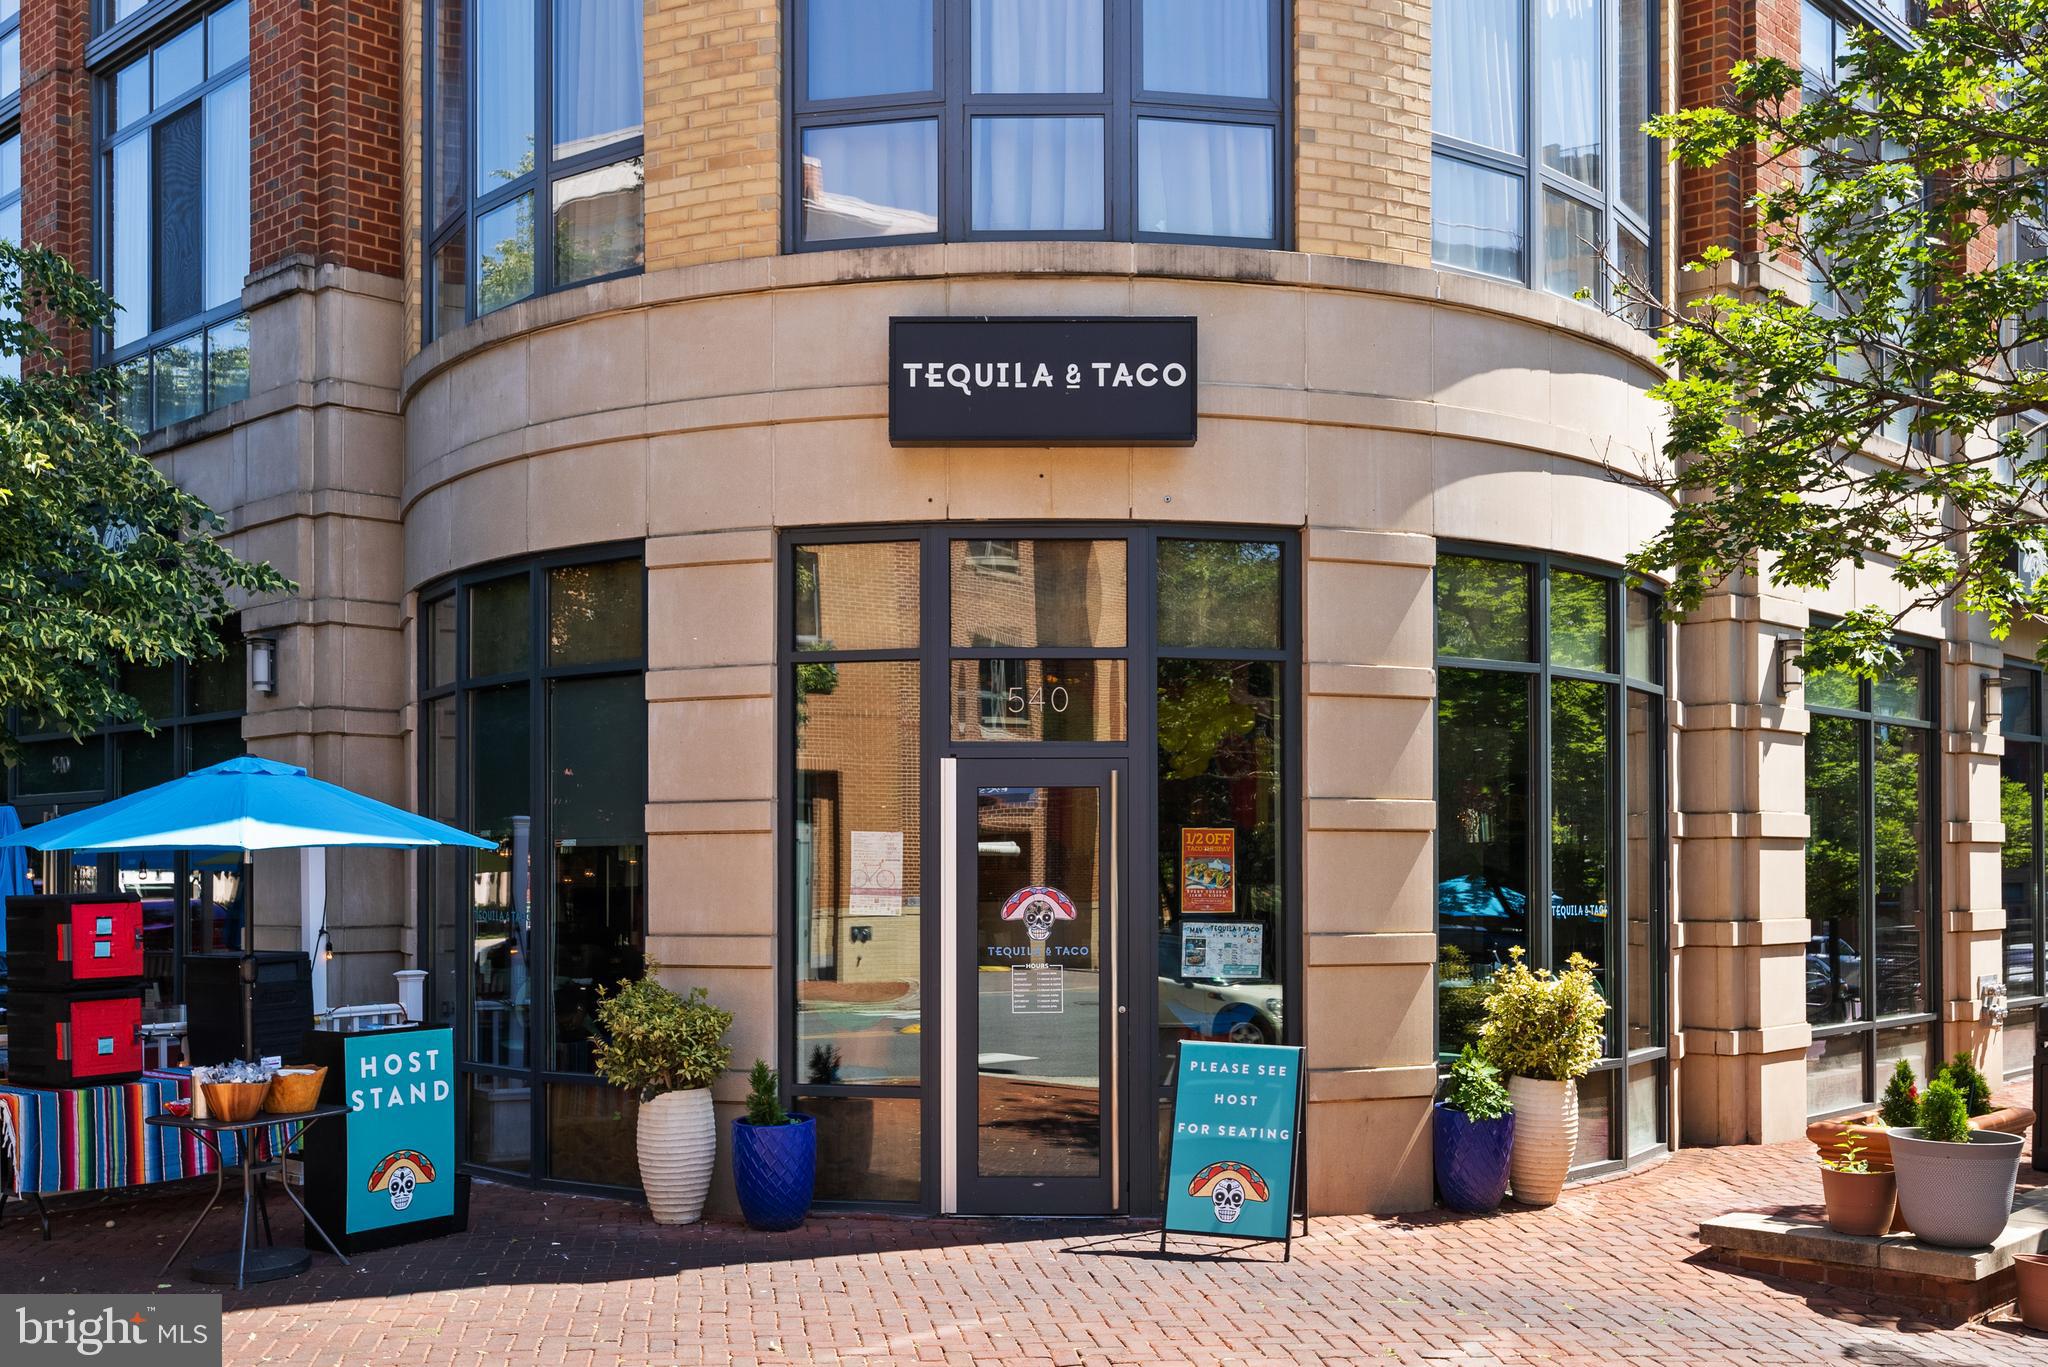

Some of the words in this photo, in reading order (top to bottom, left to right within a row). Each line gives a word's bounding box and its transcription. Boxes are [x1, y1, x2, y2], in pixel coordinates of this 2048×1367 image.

[902, 362, 1053, 396] TEQUILA
[1065, 363, 1081, 389] &
[1091, 362, 1187, 388] TACO
[1008, 686, 1069, 713] 540
[1185, 832, 1204, 845] 1/2
[1205, 832, 1231, 845] OFF
[1551, 904, 1583, 919] TEQUILA
[1210, 925, 1237, 933] TEQUILA
[987, 946, 1041, 959] TEQUILA
[1045, 947, 1052, 957] &
[1055, 946, 1090, 956] TACO
[361, 1049, 439, 1079] HOST
[1190, 1061, 1250, 1075] PLEASE
[1257, 1065, 1287, 1077] SEE
[351, 1080, 450, 1112] STAND
[1214, 1093, 1258, 1106] HOST
[1177, 1122, 1210, 1135] FOR
[1218, 1125, 1290, 1140] SEATING
